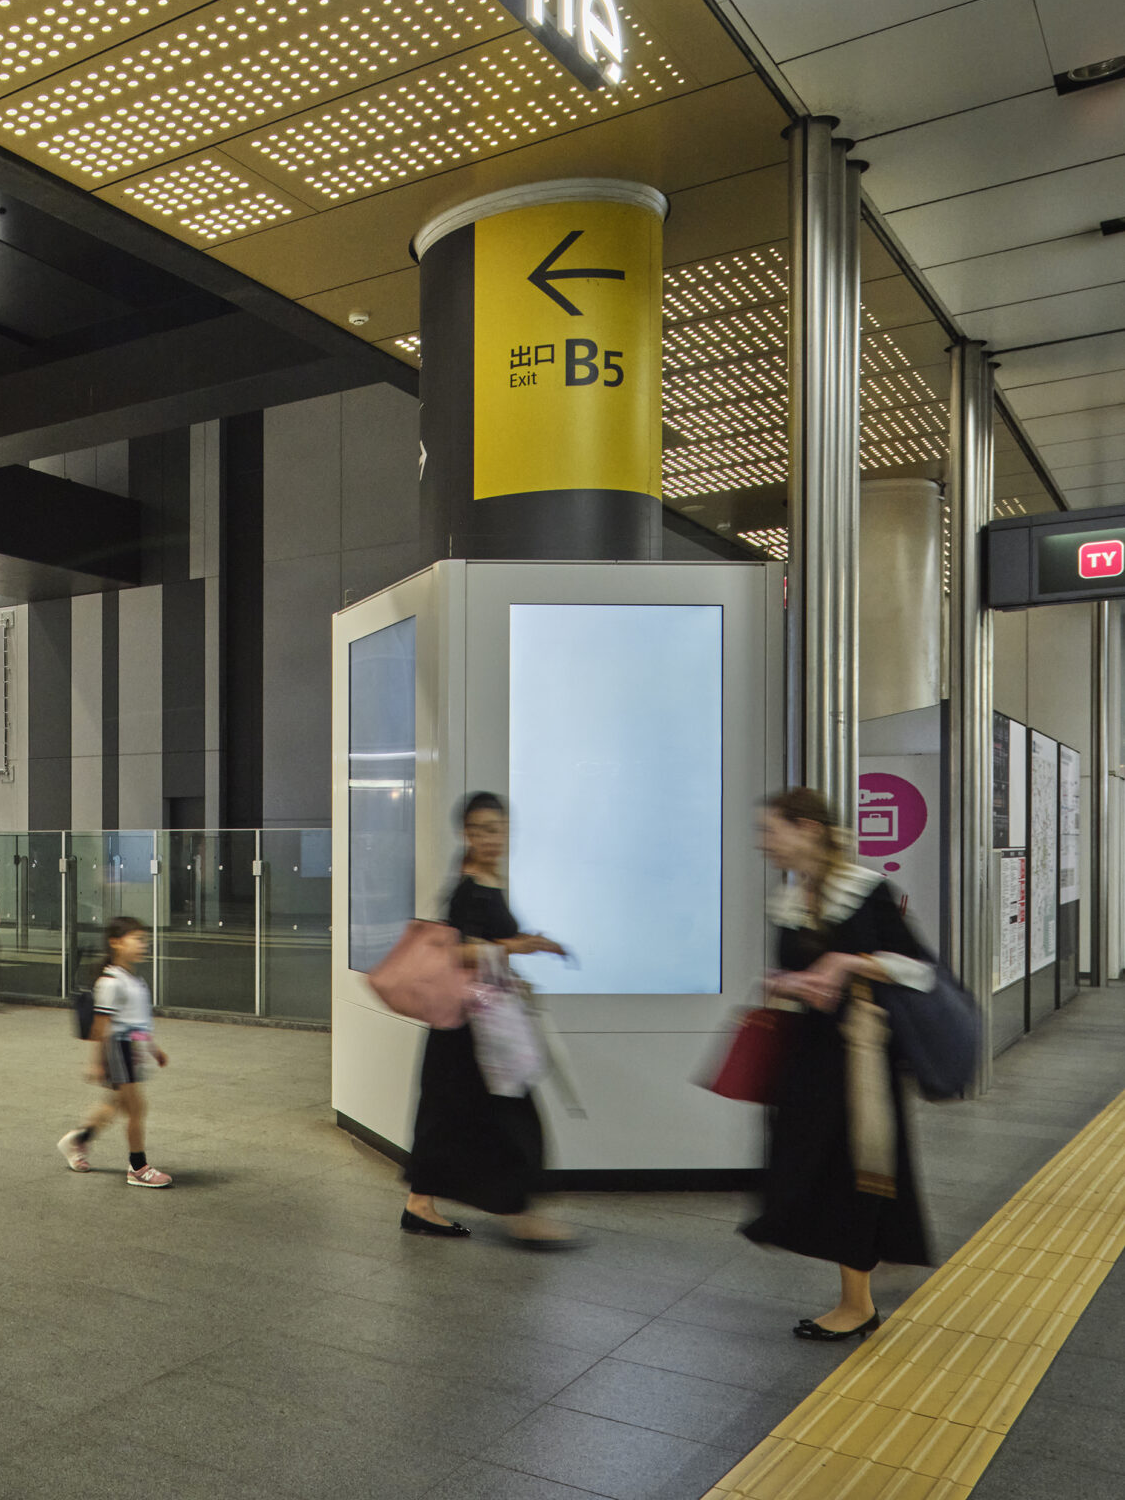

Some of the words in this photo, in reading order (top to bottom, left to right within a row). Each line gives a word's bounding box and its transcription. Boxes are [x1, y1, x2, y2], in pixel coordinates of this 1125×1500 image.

[510, 344, 555, 370] 出口
[565, 338, 625, 388] B5
[509, 371, 538, 388] Exit
[1086, 550, 1117, 568] TY
